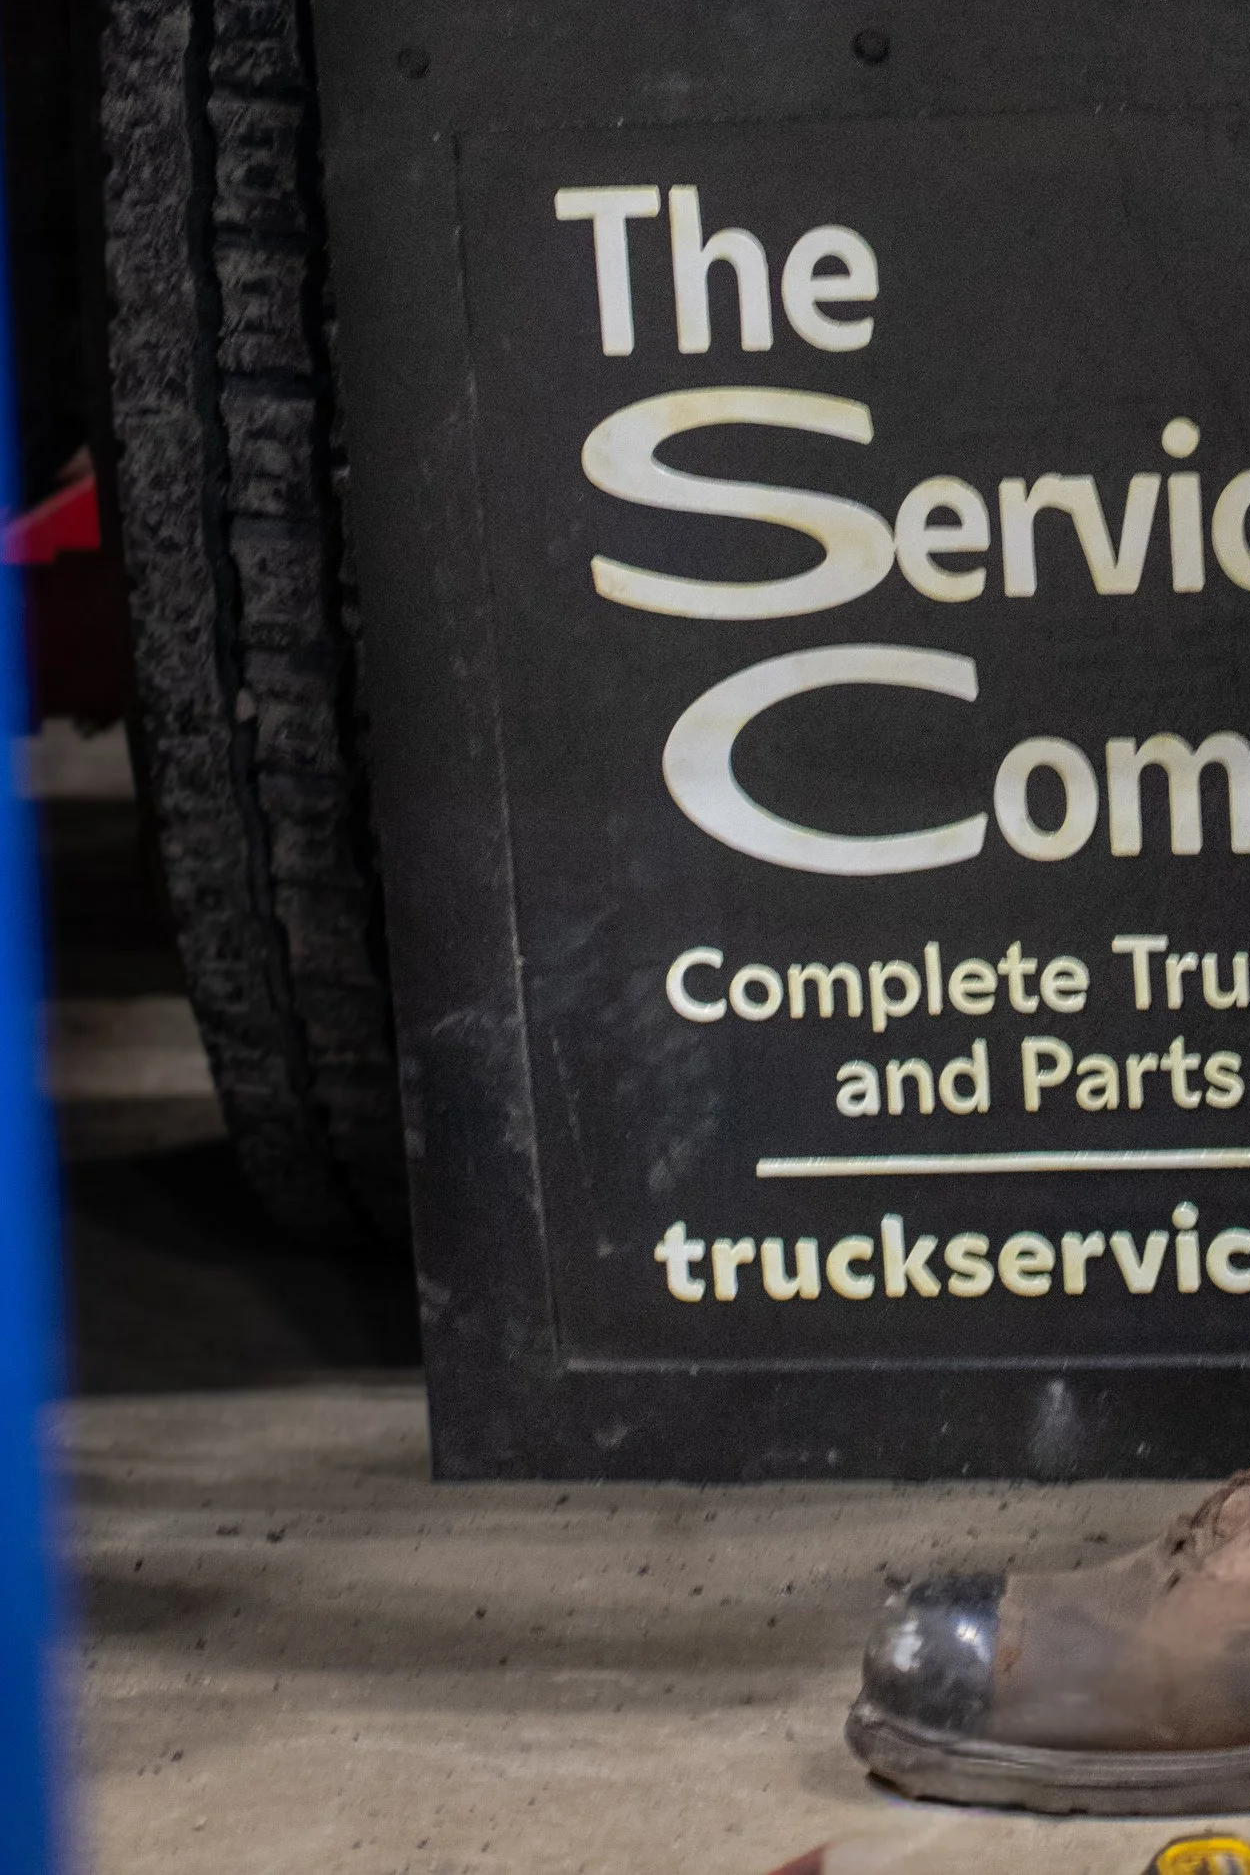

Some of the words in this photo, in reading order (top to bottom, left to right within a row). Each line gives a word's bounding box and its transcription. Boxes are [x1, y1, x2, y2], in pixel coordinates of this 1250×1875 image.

[554, 185, 880, 356] The
[665, 940, 1090, 1033] Complete
[836, 1037, 992, 1117] and
[1020, 1035, 1244, 1113] Parts
